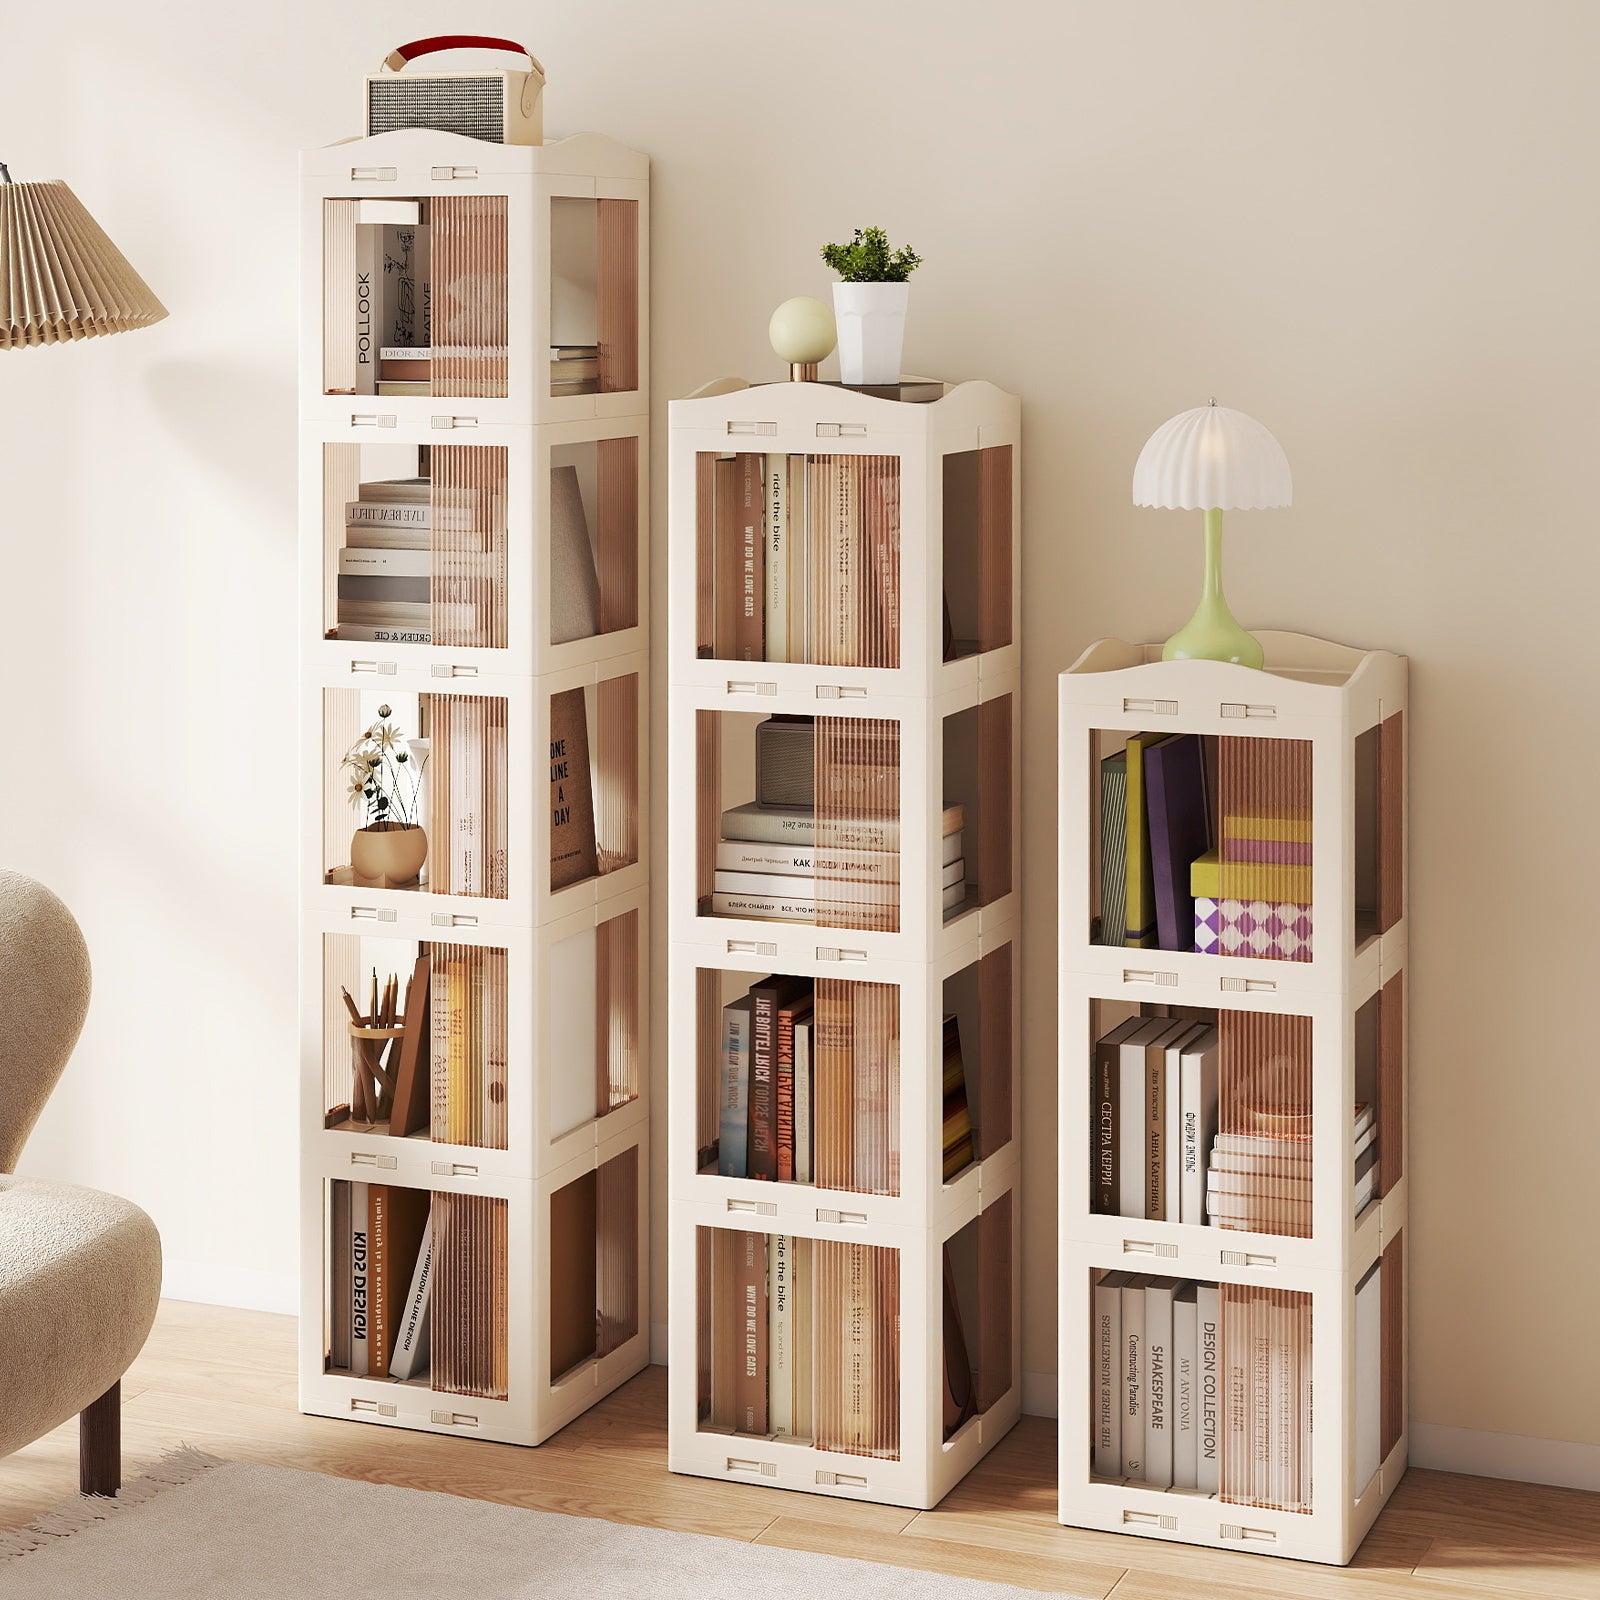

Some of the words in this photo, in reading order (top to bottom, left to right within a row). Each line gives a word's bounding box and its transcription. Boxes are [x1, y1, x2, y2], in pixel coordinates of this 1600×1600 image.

[358, 272, 370, 364] POLLOCK
[772, 473, 781, 498] ride
[772, 501, 781, 522] the
[744, 525, 753, 545] WHY
[772, 525, 781, 552] bike
[744, 547, 753, 558] DO
[744, 561, 753, 574] WE
[744, 576, 753, 595] LOVE
[744, 597, 753, 617] CATS
[550, 739, 566, 759] ONE
[550, 761, 569, 782] LINE
[558, 785, 565, 804] A
[554, 806, 570, 827] DAY
[782, 821, 796, 830] Zeit
[798, 821, 814, 830] neue
[793, 858, 811, 868] КАК
[1101, 1102, 1112, 1146] СЕСТРА
[1185, 1112, 1196, 1143] ФРИДРИХ
[1151, 1130, 1160, 1159] АННА
[1101, 1148, 1112, 1186] КЕРРИ
[1185, 1145, 1196, 1174] ЭНГЕЛЬС
[1151, 1161, 1160, 1212] КАРЕНИНА
[776, 1233, 786, 1258] ride
[776, 1261, 786, 1282] the
[746, 1285, 756, 1304] WHY
[776, 1285, 786, 1312] bike
[746, 1305, 756, 1317] DO
[746, 1318, 756, 1333] WE
[746, 1333, 756, 1354] LOVE
[1101, 1314, 1111, 1387] MUSKETEERS
[1203, 1322, 1216, 1372] DESIGN
[746, 1355, 756, 1377] CATS
[1127, 1334, 1140, 1382] Constructing
[1180, 1358, 1190, 1376] MY
[1254, 1336, 1271, 1383] DESIGN
[1279, 1343, 1291, 1389] DESIGN
[1128, 1384, 1140, 1416] Paradies
[1151, 1345, 1163, 1430] SHAKESPEARE
[1101, 1389, 1111, 1425] THREE
[1180, 1378, 1190, 1431] ANTONIA
[1203, 1373, 1216, 1459] COLLECTION
[1254, 1385, 1271, 1462] COLLECTION
[1279, 1391, 1291, 1468] COLLECTION
[1101, 1427, 1111, 1449] THE
